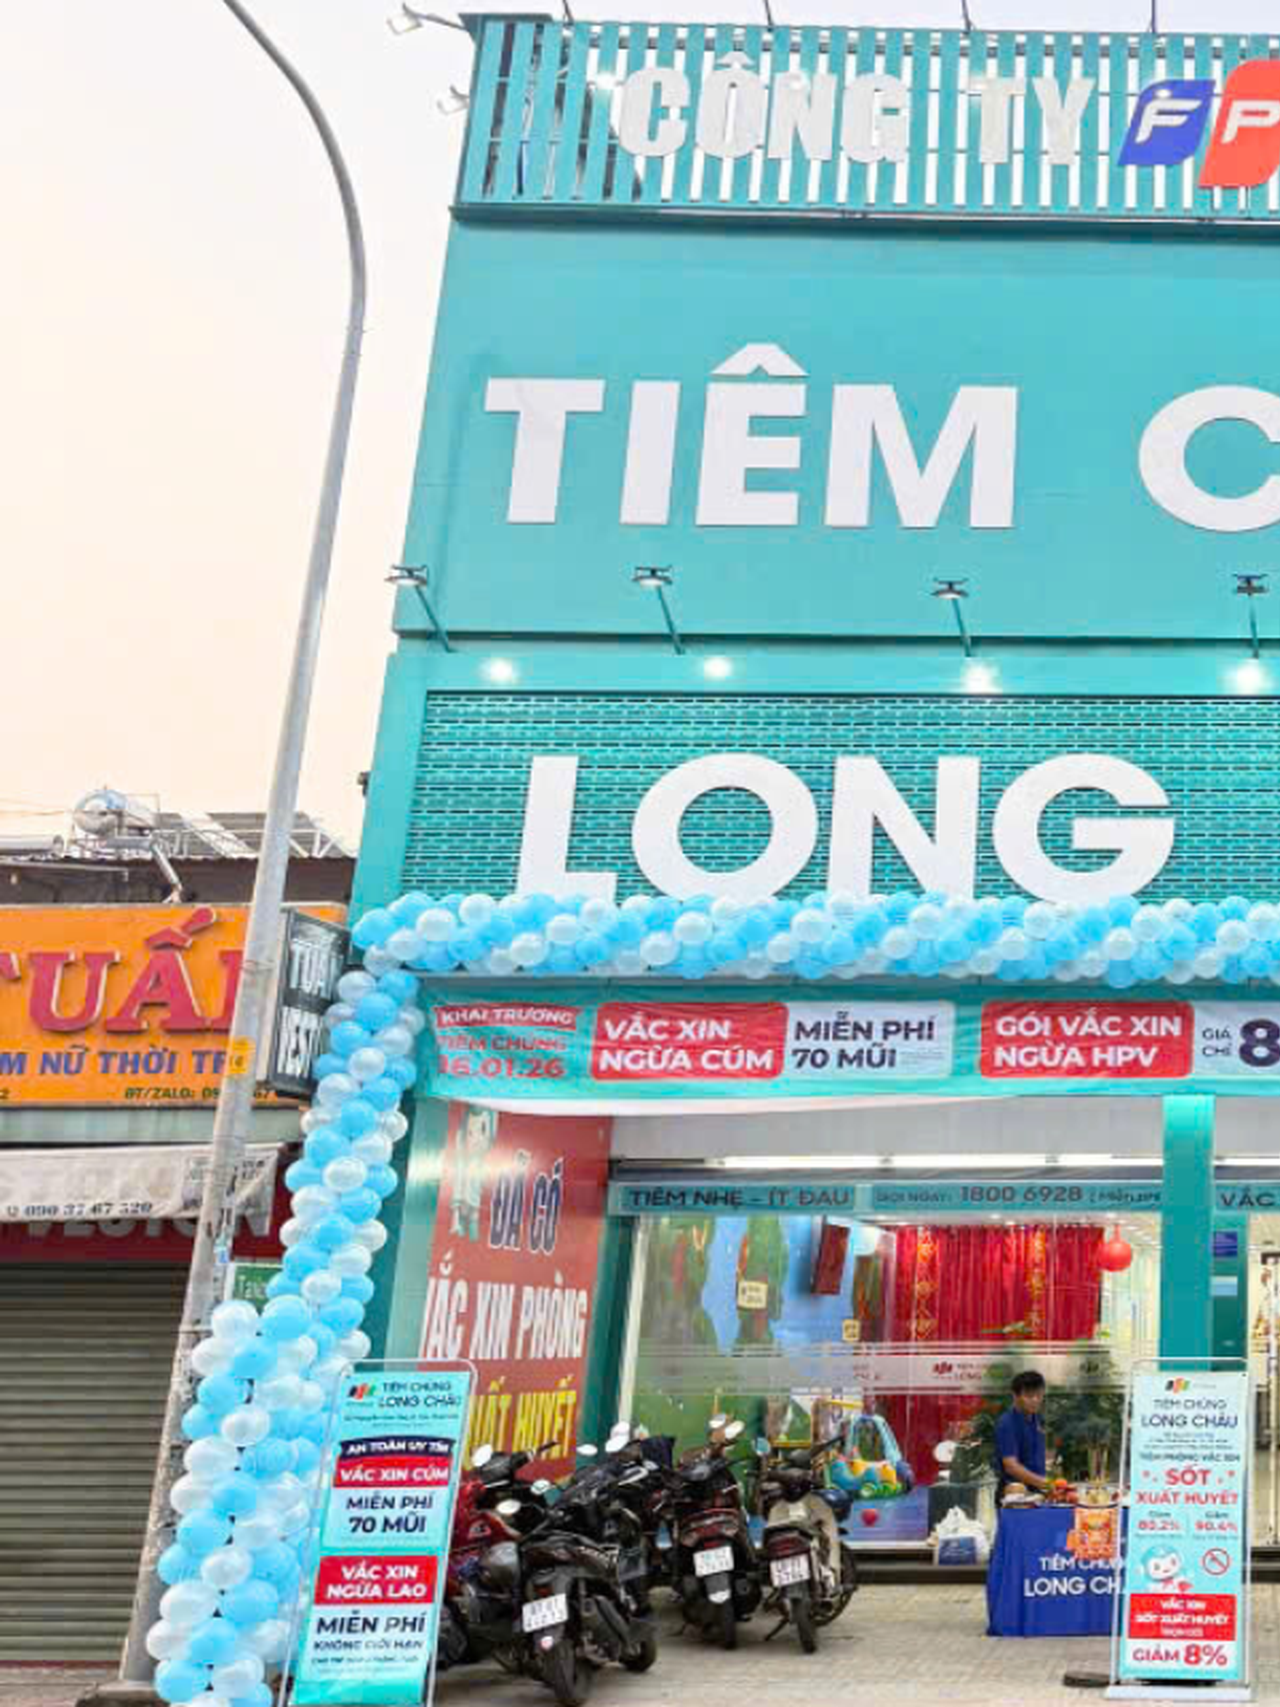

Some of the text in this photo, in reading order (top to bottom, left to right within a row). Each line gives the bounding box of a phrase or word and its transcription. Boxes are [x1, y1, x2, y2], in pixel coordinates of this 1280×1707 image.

[617, 51, 912, 164] CÔNG
[974, 76, 1095, 166] TY
[484, 343, 1019, 529] TIÊM
[515, 752, 1176, 906] LONG
[442, 1006, 573, 1025] KHAI TRƯƠNG
[604, 1013, 731, 1041] VẮC XIN
[794, 1011, 937, 1041] MIỄN PHÍ
[996, 1009, 1182, 1036] GÓI VẮC XIN
[1202, 1025, 1232, 1040] GIÁ
[39, 1044, 90, 1075] NỮ
[100, 1046, 180, 1075] THỜI
[438, 1054, 566, 1079] 16.01.26
[600, 1044, 774, 1071] NGỪA CÚM
[791, 1048, 828, 1069] 70
[837, 1045, 897, 1069] MŨI
[994, 1045, 1159, 1069] NGỪA HPV
[630, 1186, 686, 1207] TIÊM
[689, 1189, 743, 1208] NHẸ
[960, 1185, 1016, 1203] 1800
[1023, 1185, 1082, 1203] 6928
[1220, 1186, 1280, 1209] VẮC
[469, 1280, 516, 1360] XIN
[381, 1467, 408, 1482] XIN
[412, 1463, 449, 1482] CÚM
[1165, 1464, 1212, 1486] SỐT
[346, 1490, 434, 1511] MIỄN PHÍ
[349, 1511, 426, 1534] 70 MŨI
[341, 1562, 418, 1581] VẮC XIN
[388, 1584, 426, 1599] LAO
[1023, 1576, 1087, 1597] LONG
[317, 1609, 428, 1635] MIỄN PHÍ
[1183, 1644, 1228, 1667] 8%
